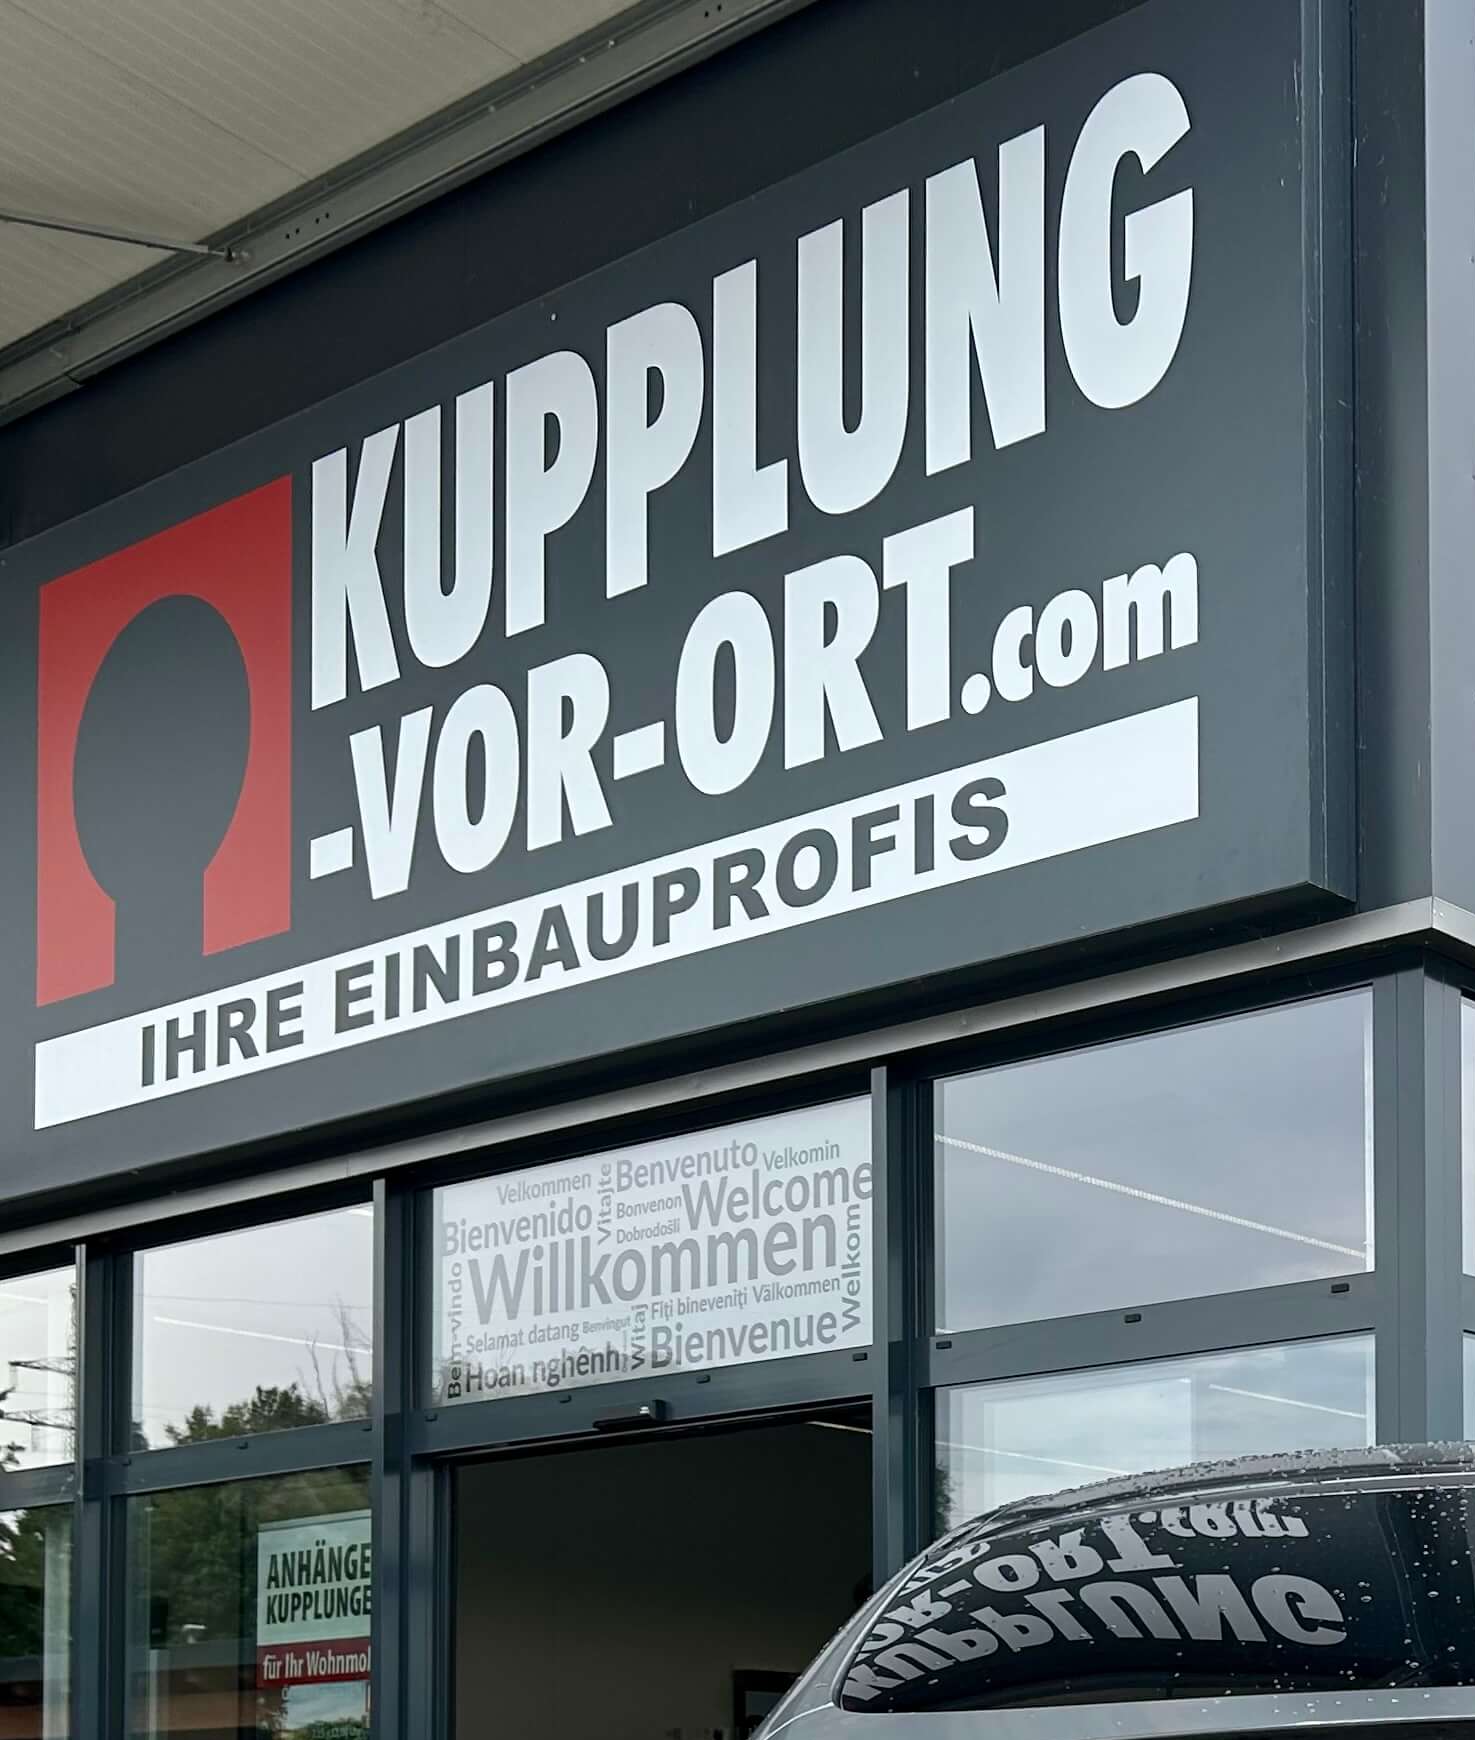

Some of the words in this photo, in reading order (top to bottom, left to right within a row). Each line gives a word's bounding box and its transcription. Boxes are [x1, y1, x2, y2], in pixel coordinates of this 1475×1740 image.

[310, 72, 1194, 711] KUPPLUNG
[310, 506, 1200, 899] -VOR-ORT.com
[139, 980, 305, 1088] IHRE
[333, 774, 1010, 1034] EINBAUPROFIS
[616, 1140, 758, 1193] Benvenuto
[762, 1140, 841, 1172] Velkomin
[497, 1173, 592, 1205] Velkommen
[597, 1163, 614, 1246] Vitajte
[616, 1195, 682, 1219] Bonvenon
[681, 1162, 872, 1231] Welcome
[443, 1197, 593, 1257] Bienvenido
[468, 1213, 837, 1325] Willkommen
[752, 1277, 841, 1304] Välkommen
[841, 1203, 862, 1333] Welkom
[447, 1262, 462, 1399] Bem-vindo
[466, 1331, 525, 1354] Selamat
[528, 1321, 580, 1342] datang
[651, 1311, 837, 1368] Bienvenue
[466, 1361, 525, 1392] Hoan
[533, 1340, 619, 1387] nghênh
[266, 1539, 371, 1590] ANHÄNGE
[263, 1653, 282, 1680] für
[285, 1652, 304, 1679] Ihr
